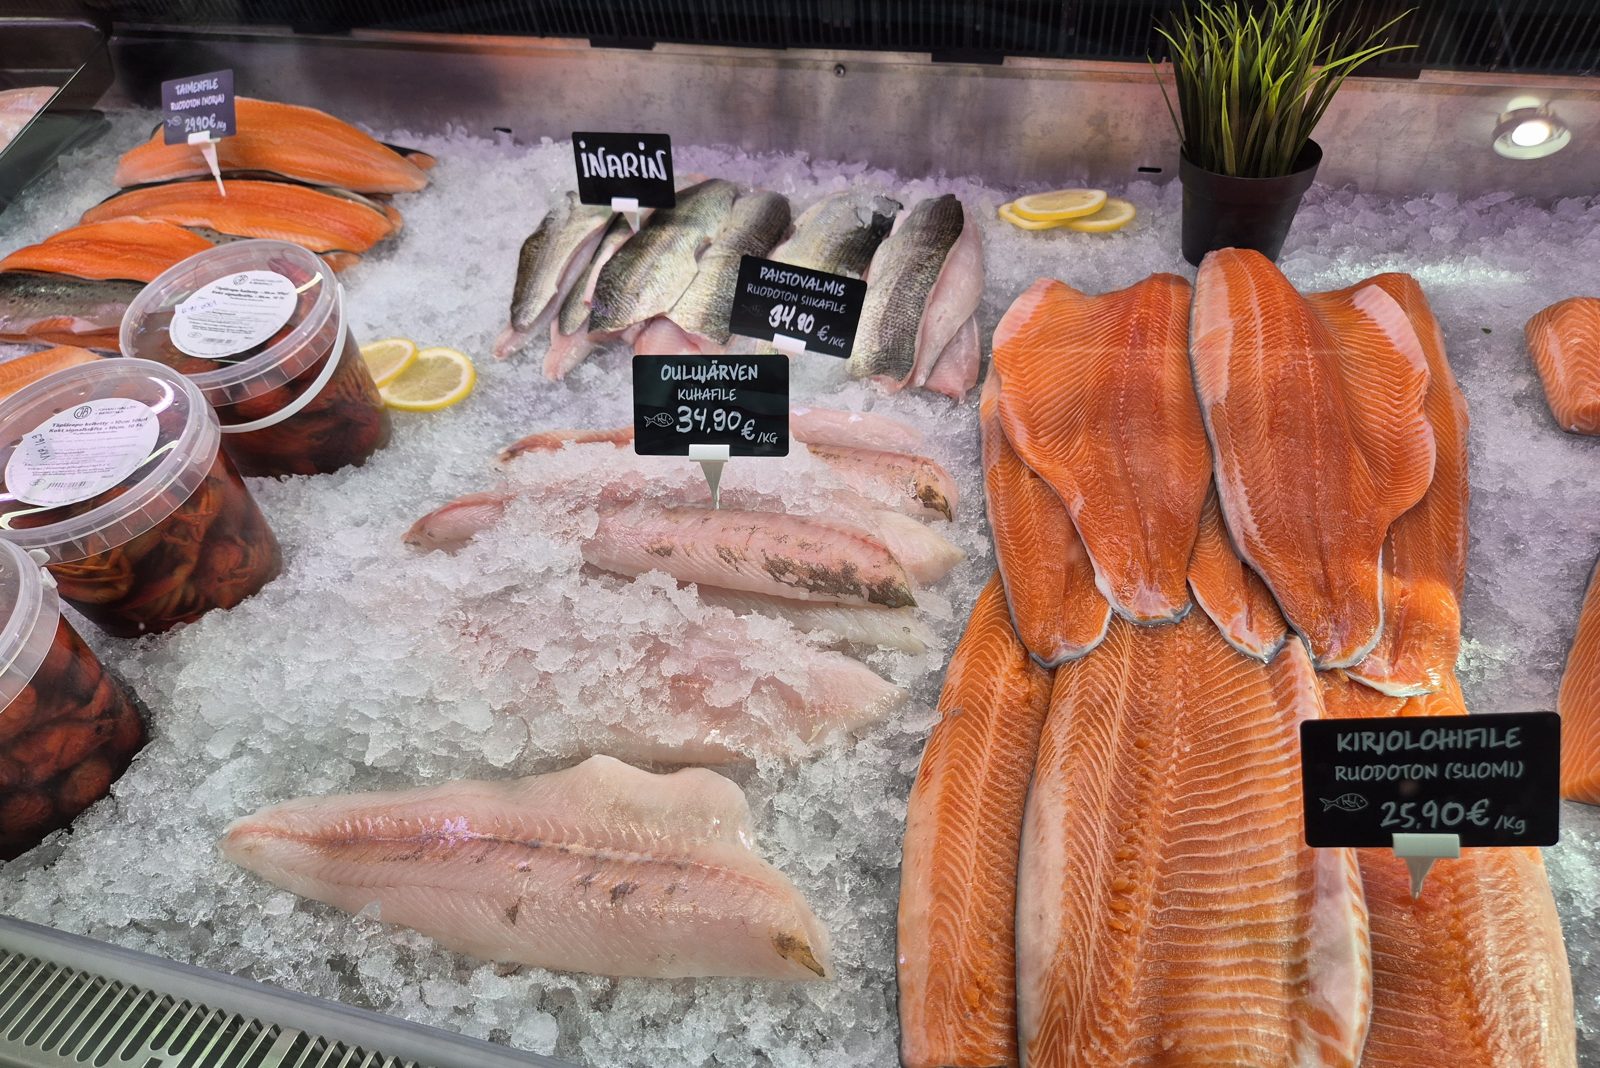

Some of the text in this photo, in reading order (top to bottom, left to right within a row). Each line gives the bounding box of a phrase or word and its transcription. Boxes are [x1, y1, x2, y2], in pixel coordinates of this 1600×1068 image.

[175, 78, 219, 96] TAIMENFILE
[170, 98, 201, 111] RUODOTON
[759, 265, 847, 297] PAISTOVALMIS
[746, 283, 847, 314] RUODOTON SIIKAFILE
[816, 325, 831, 342] €
[828, 336, 847, 349] /KG
[660, 359, 758, 383] OULUJÄRVEN
[677, 388, 737, 402] KUHAFILE
[757, 431, 779, 444] /KG
[1336, 726, 1522, 755] KIRJOLOHIFILE
[1334, 760, 1524, 782] RUODOTON (SUOMI)
